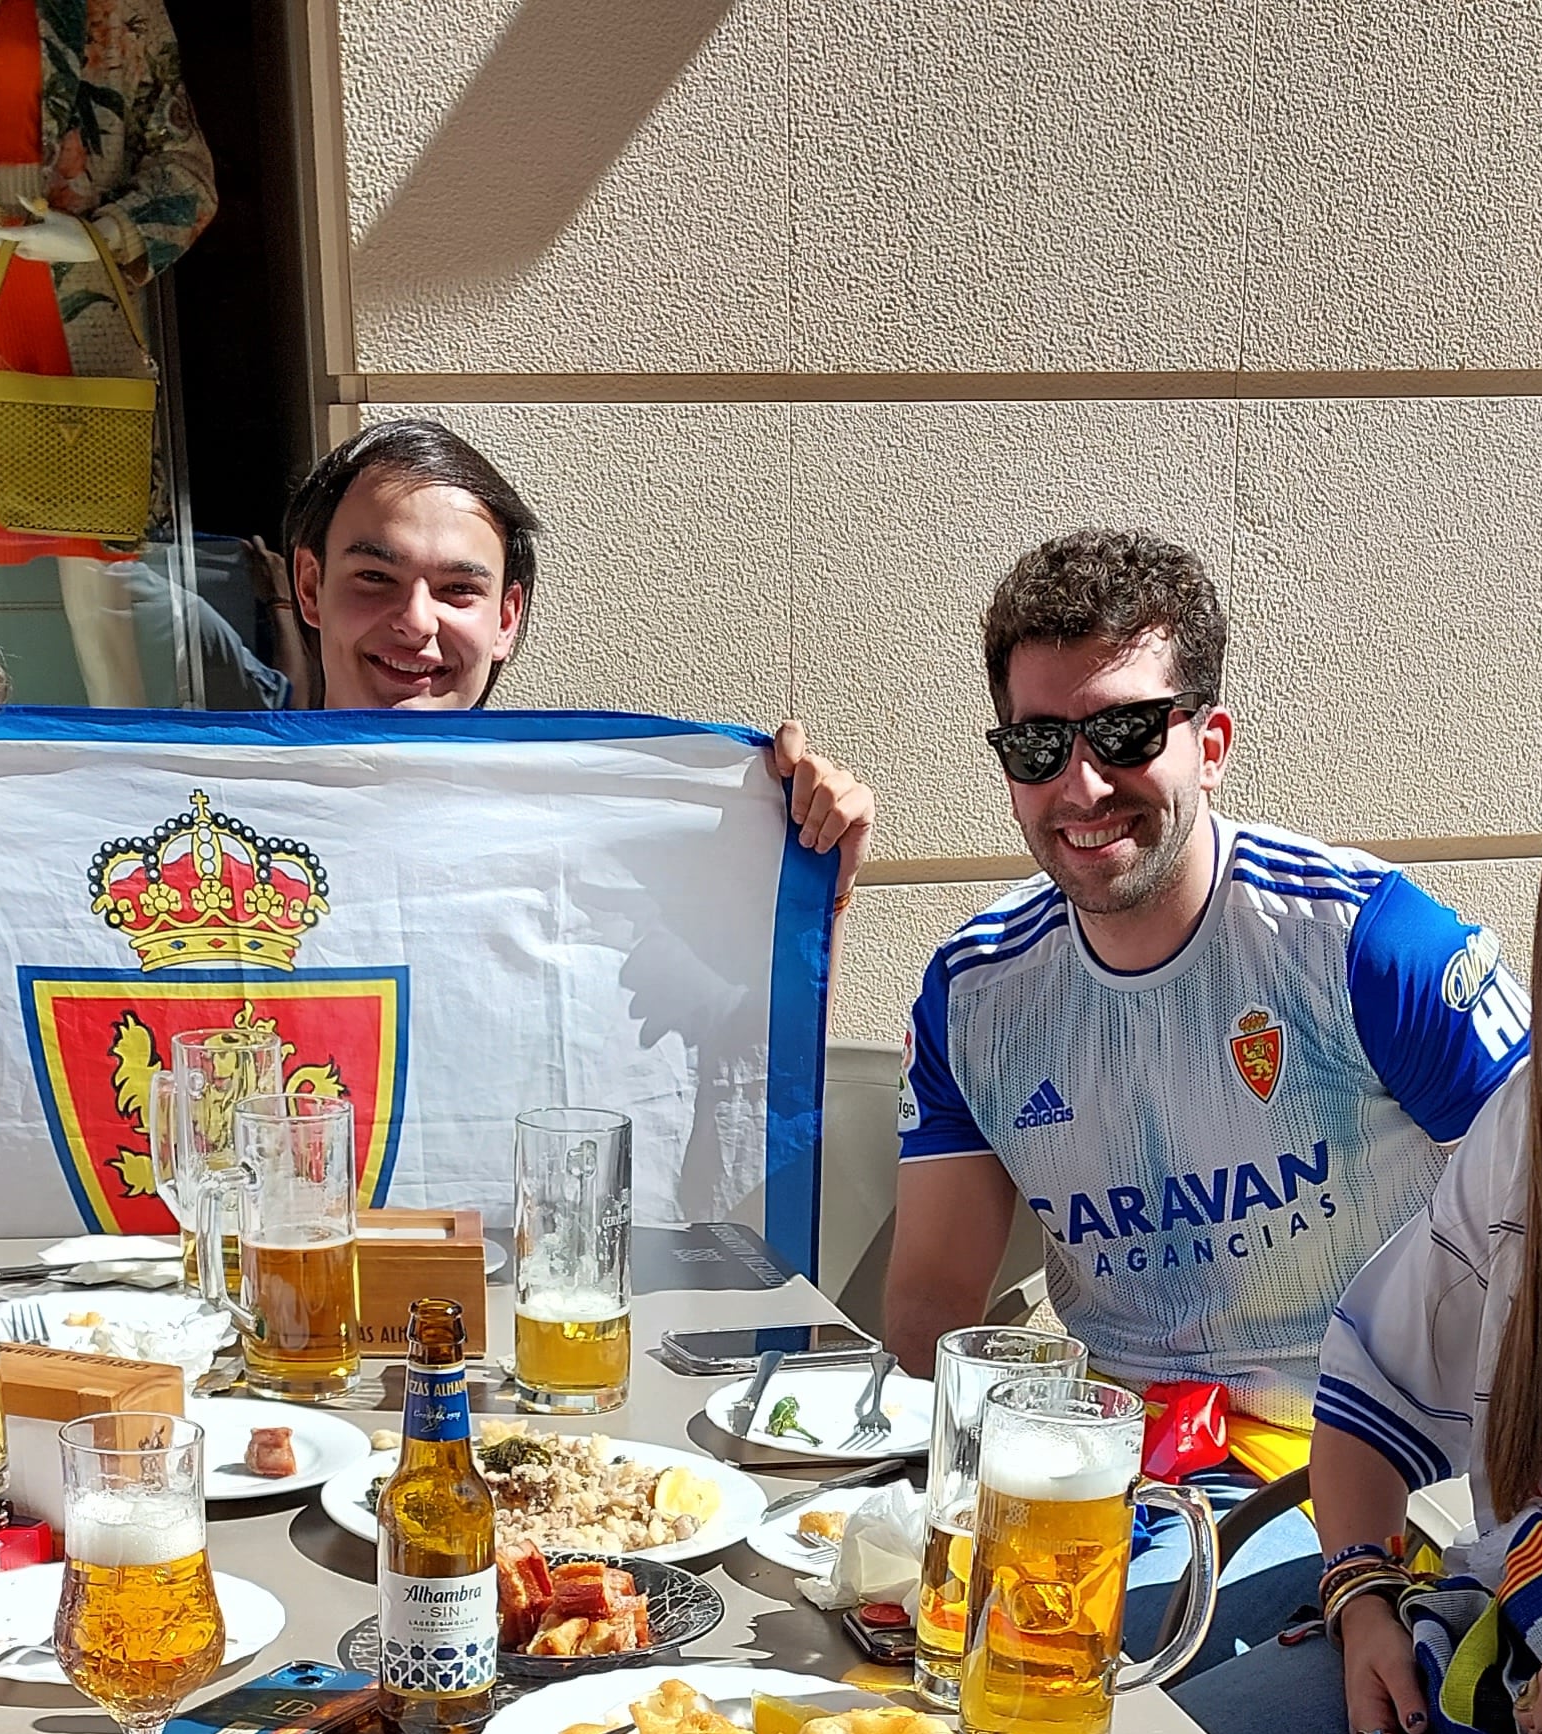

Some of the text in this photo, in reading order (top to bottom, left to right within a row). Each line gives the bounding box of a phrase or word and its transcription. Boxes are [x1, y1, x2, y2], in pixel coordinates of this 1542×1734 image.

[1014, 1106, 1074, 1130] adidas
[1095, 1192, 1337, 1279] AGANCIAS
[403, 1584, 482, 1604] Alhambra
[429, 1606, 460, 1618] SIN
